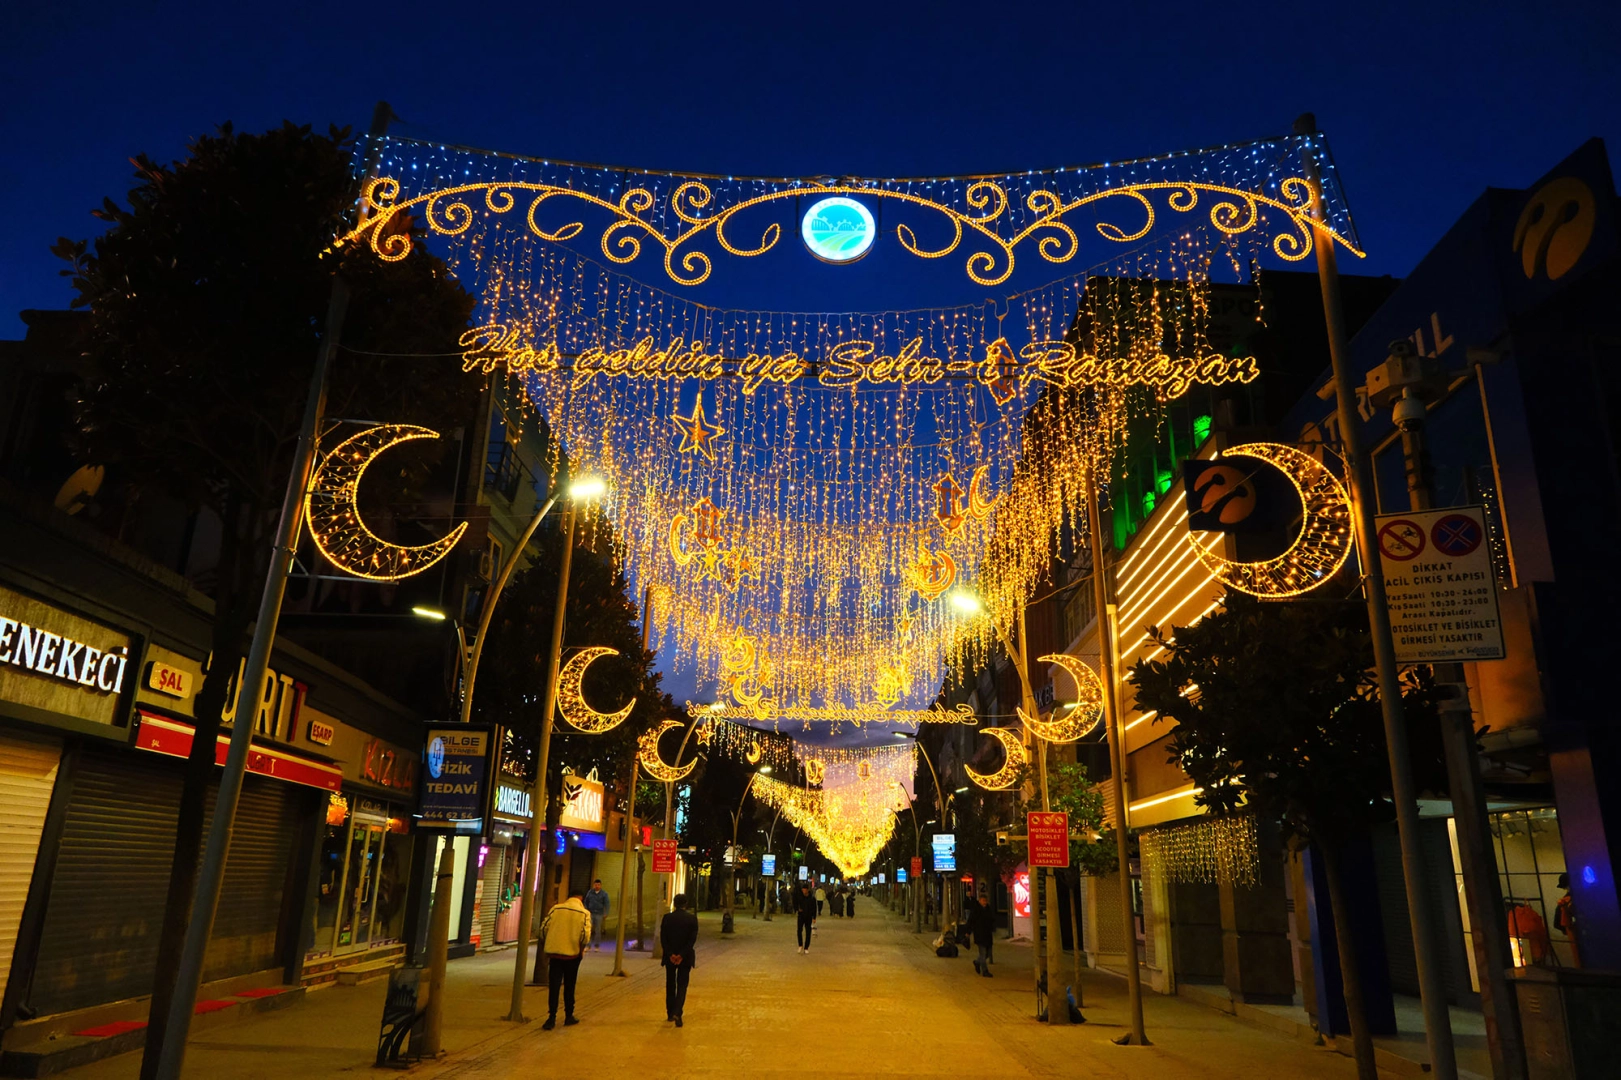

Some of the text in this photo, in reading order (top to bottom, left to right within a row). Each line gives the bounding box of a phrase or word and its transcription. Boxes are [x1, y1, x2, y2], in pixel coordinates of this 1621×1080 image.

[739, 352, 806, 395] ya
[1019, 340, 1261, 399] Ramazan
[1412, 562, 1453, 573] DİKKAT
[1386, 576, 1410, 587] ACİL
[1446, 571, 1485, 583] KAPISI
[1392, 621, 1438, 634] OTOSİKLET
[1441, 622, 1453, 631] VE
[1401, 632, 1484, 645] GİRMESİ YASAKTIR
[159, 669, 182, 692] ŞAL
[312, 723, 333, 741] EŞARP
[437, 761, 472, 775] FİZİK
[426, 781, 478, 795] TEDAVİ
[498, 785, 531, 817] BARGELLO
[423, 811, 443, 819] 444
[446, 811, 458, 819] 62
